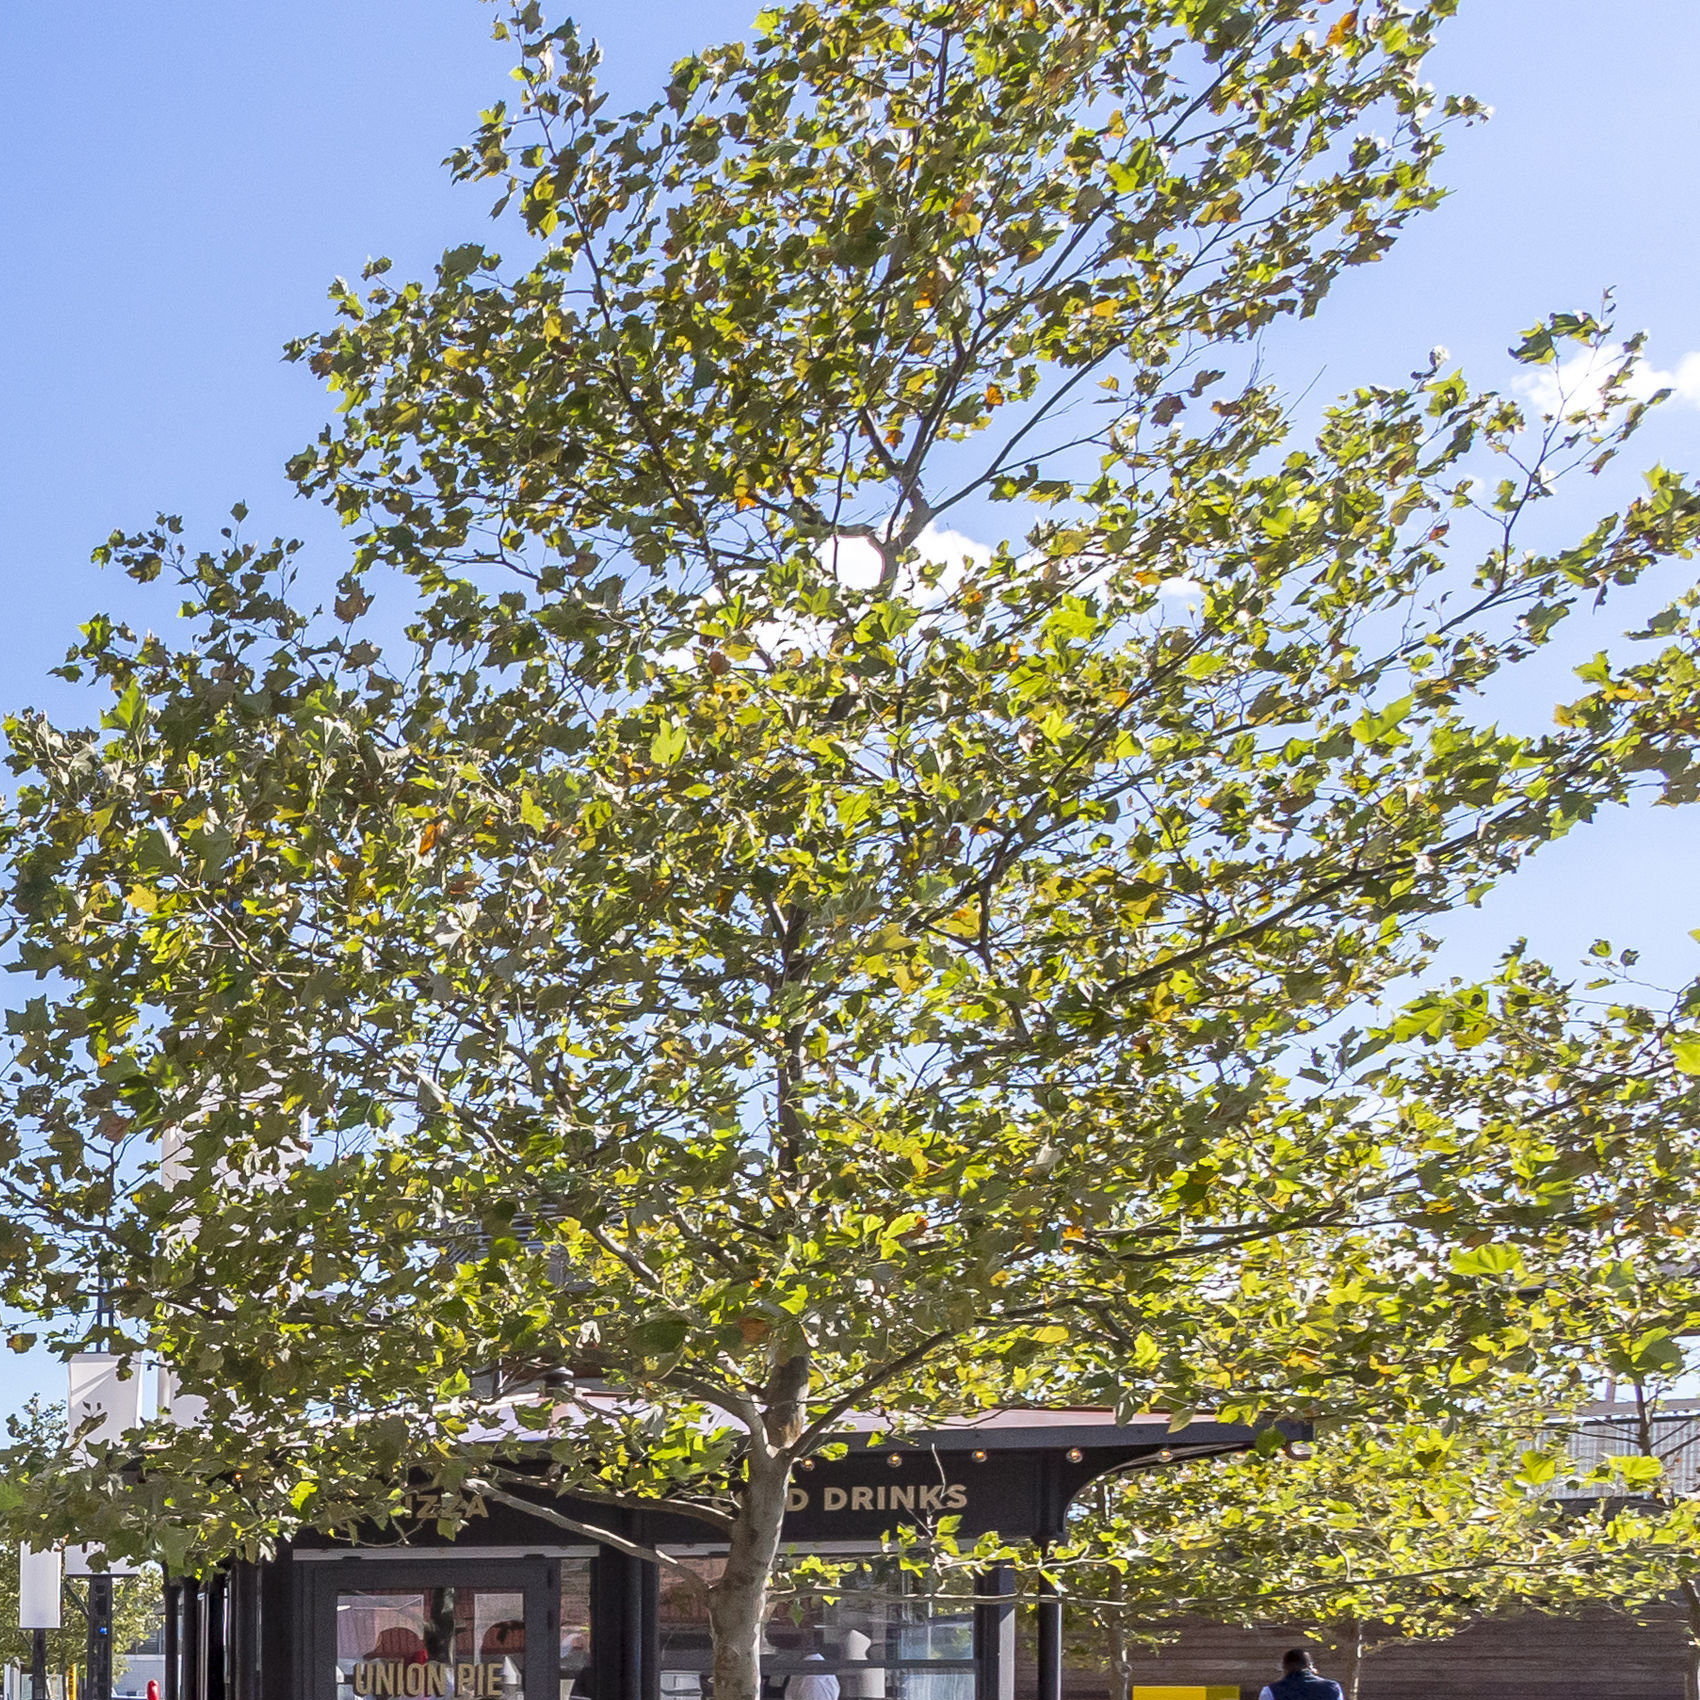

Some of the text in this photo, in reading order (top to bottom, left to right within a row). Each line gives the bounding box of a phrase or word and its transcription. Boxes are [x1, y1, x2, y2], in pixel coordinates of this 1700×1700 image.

[397, 1494, 490, 1519] IZZA
[823, 1484, 969, 1511] DRINKS
[353, 1662, 505, 1697] UNION PIE
